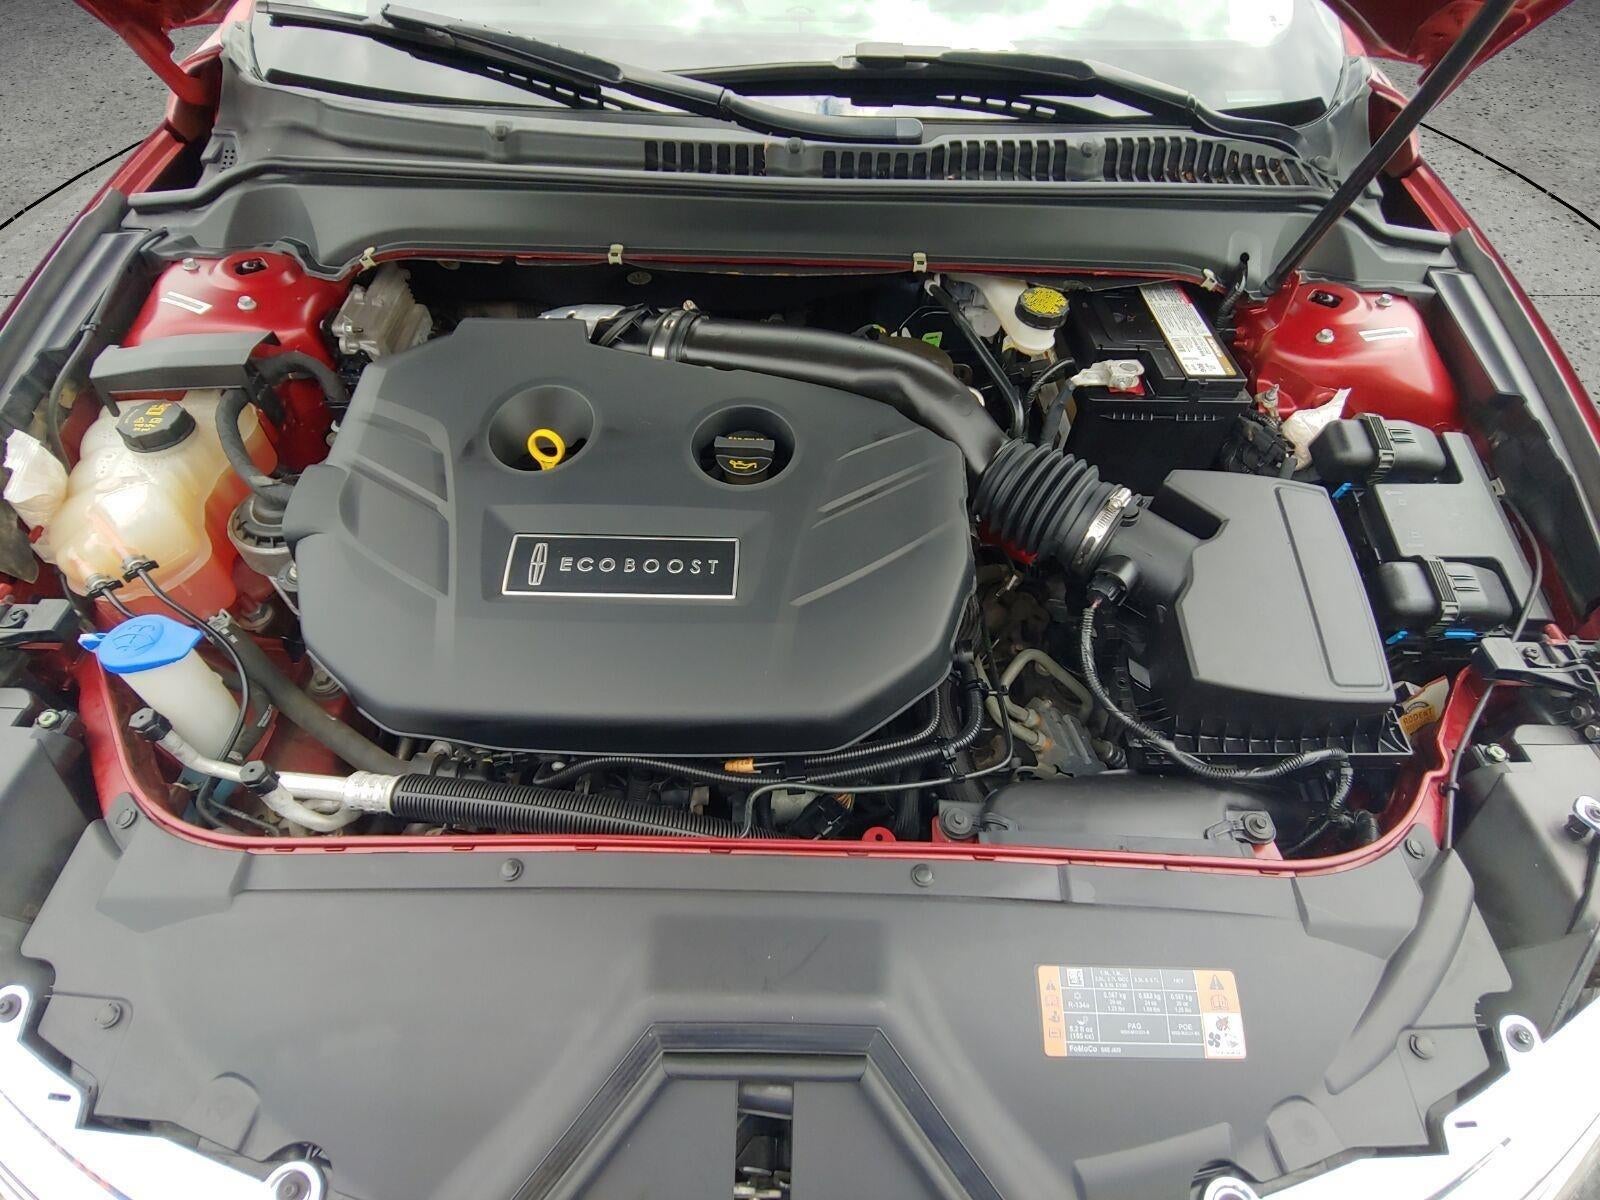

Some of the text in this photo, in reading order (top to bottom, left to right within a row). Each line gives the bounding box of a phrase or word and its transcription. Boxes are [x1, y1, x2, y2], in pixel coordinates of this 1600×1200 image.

[559, 556, 719, 575] ECOBOOST
[1402, 707, 1432, 726] RODENT
[1068, 1001, 1090, 1009] R-134a
[1069, 1044, 1098, 1053] FoMoCo
